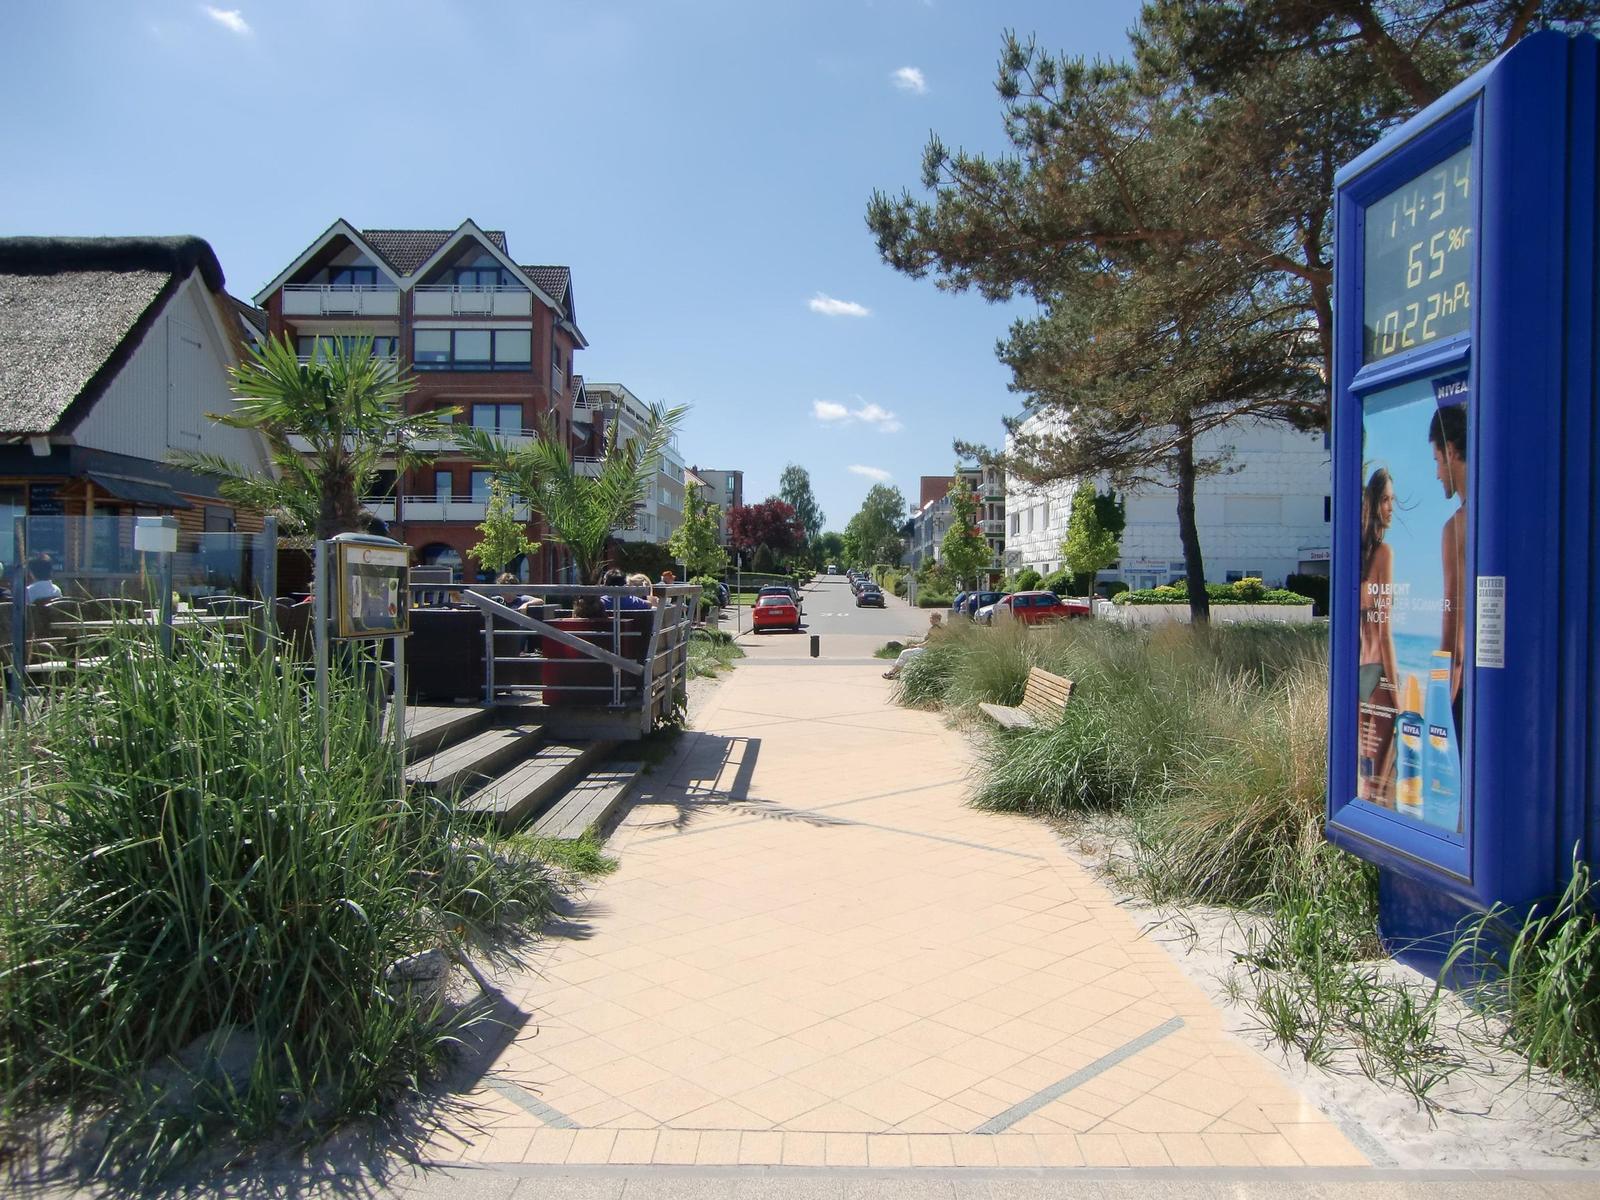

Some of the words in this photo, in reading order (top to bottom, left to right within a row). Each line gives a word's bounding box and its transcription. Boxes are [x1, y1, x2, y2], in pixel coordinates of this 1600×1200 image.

[1391, 157, 1471, 238] 14:34
[1438, 381, 1468, 399] NIVEA
[1367, 582, 1380, 595] SO
[1381, 583, 1411, 596] LEICHT
[1366, 611, 1391, 624] NOCH
[1403, 724, 1421, 736] NIVEA
[1430, 725, 1448, 737] NIVEA
